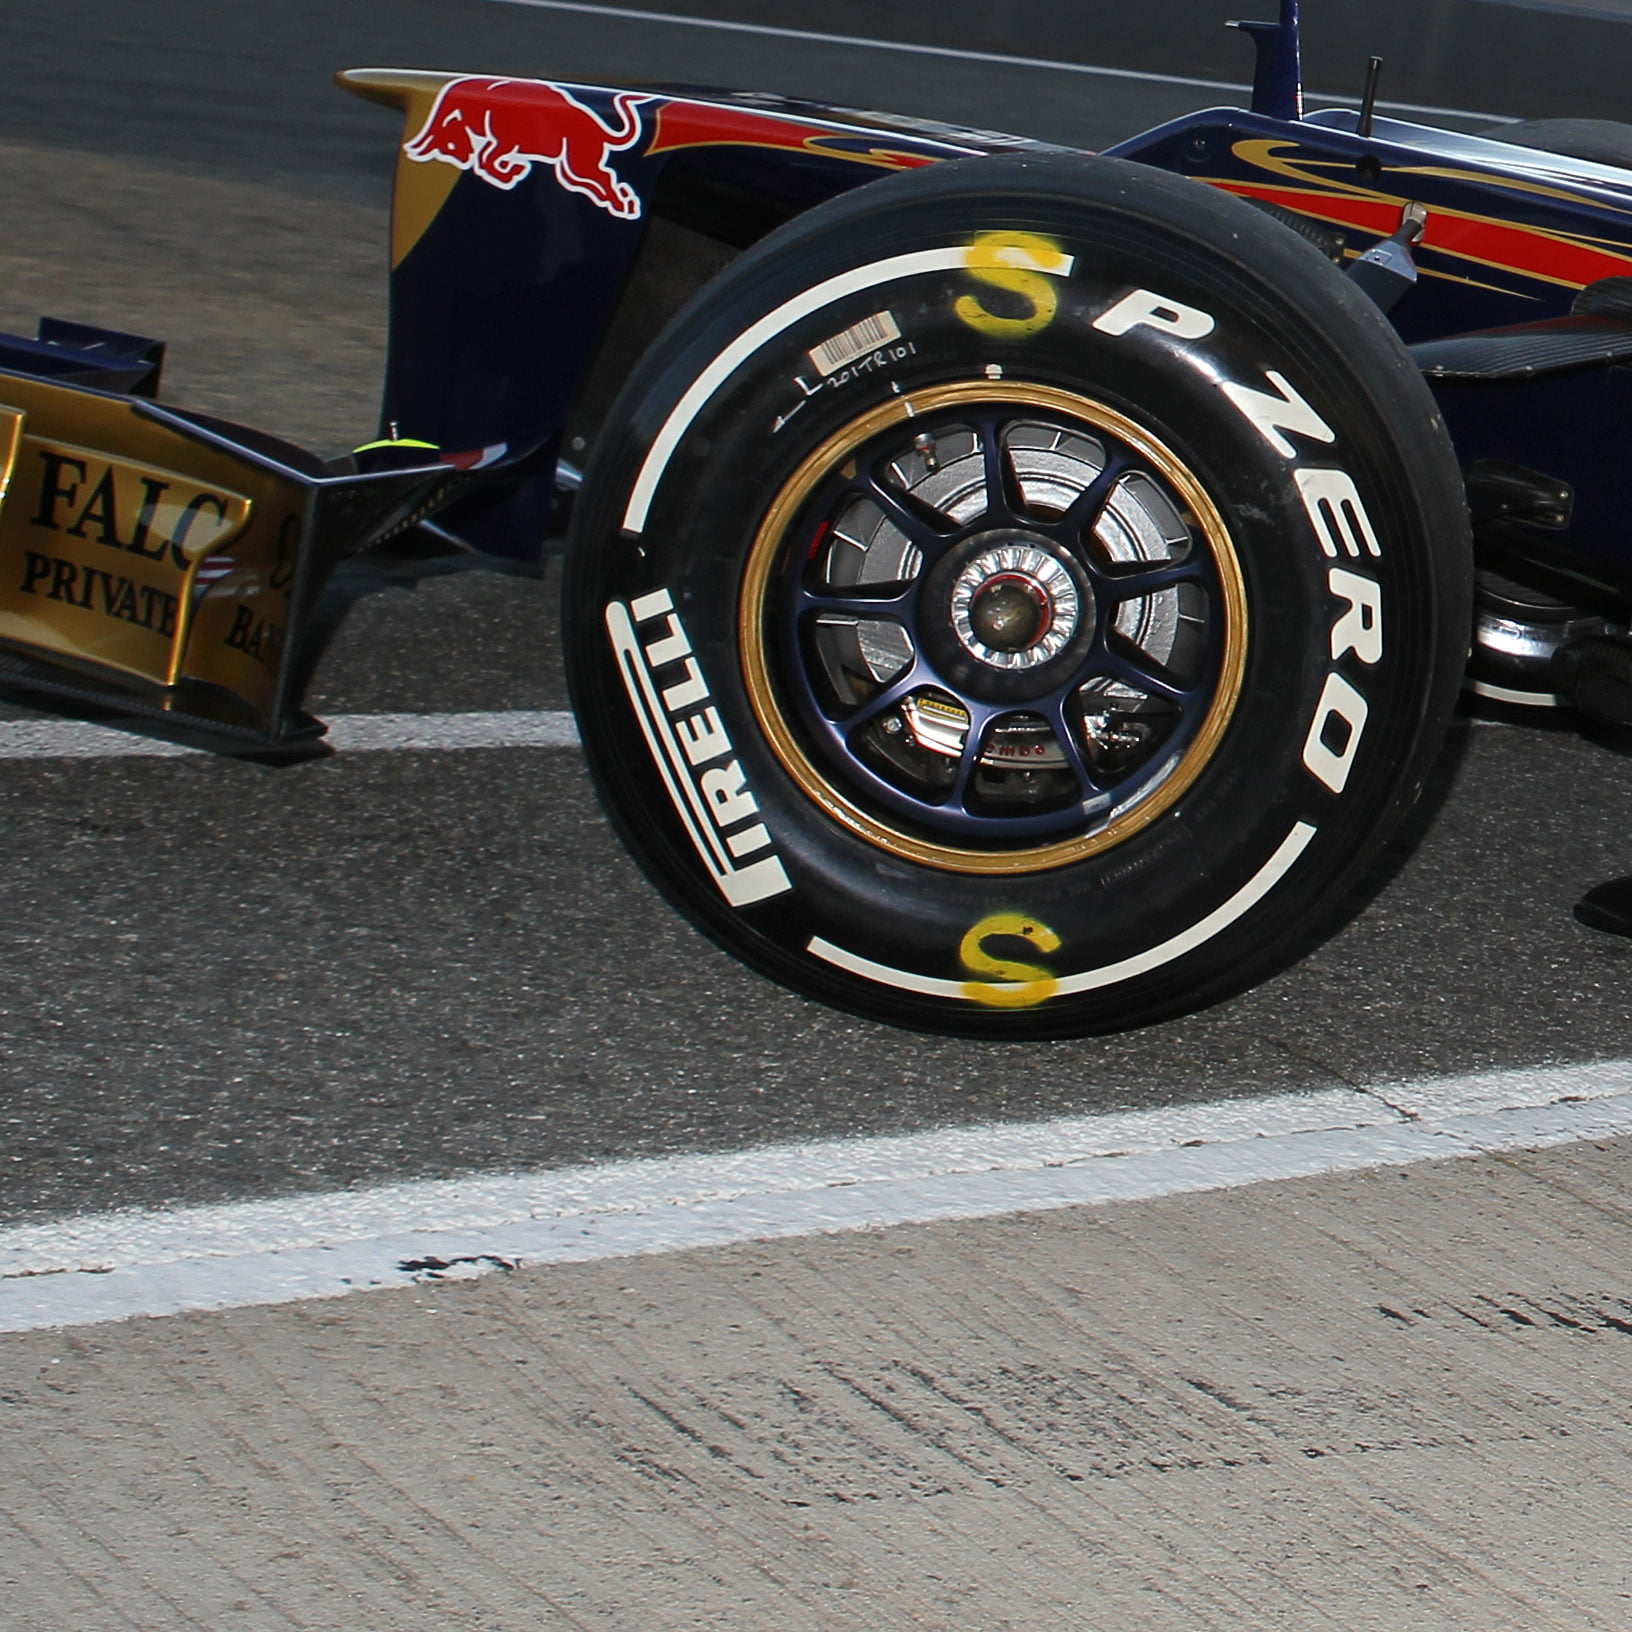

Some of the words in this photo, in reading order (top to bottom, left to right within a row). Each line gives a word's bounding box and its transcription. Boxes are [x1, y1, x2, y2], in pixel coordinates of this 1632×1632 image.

[956, 231, 1064, 337] S
[605, 588, 792, 907] PIRELLI
[960, 912, 1062, 1007] S
